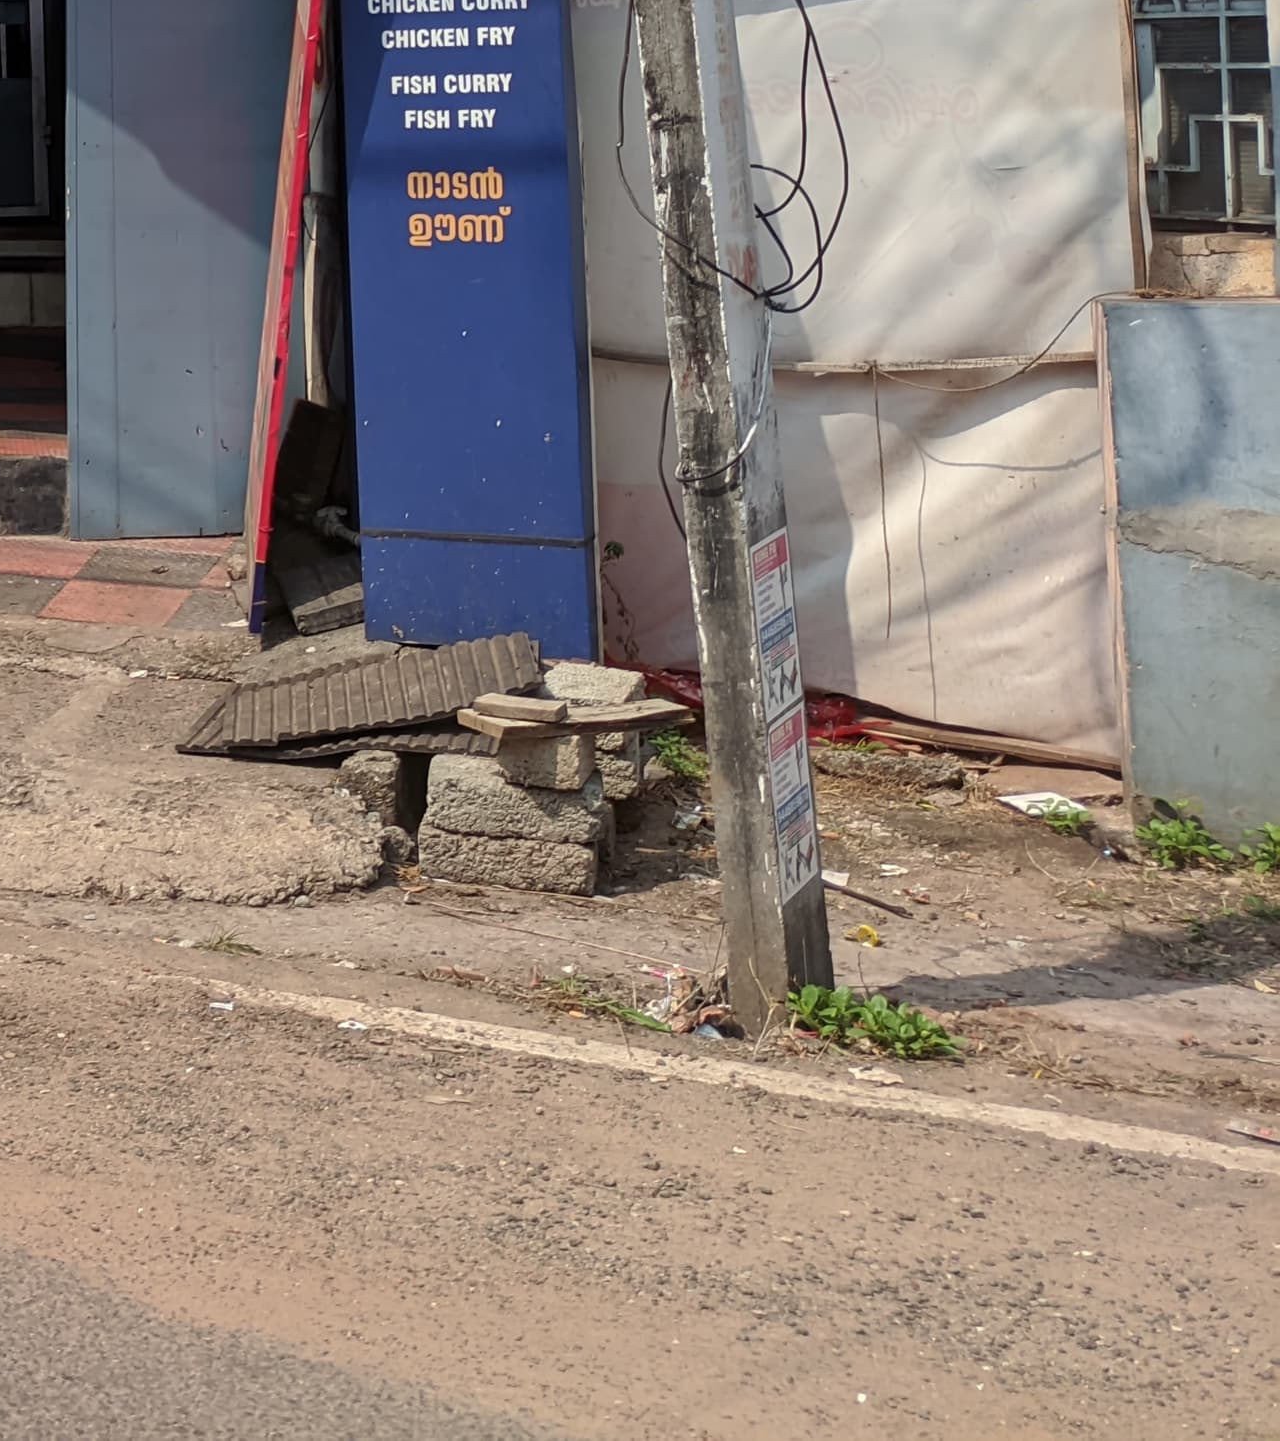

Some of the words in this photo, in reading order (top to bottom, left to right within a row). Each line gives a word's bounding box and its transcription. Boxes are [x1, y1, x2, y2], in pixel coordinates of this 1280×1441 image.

[381, 28, 469, 49] CHICKEN
[477, 26, 515, 46] FRY
[391, 75, 436, 95] FISH
[443, 73, 512, 94] CURRY
[405, 110, 450, 129] FISH
[458, 109, 496, 128] FRY
[407, 166, 503, 199] നാടൻ
[408, 206, 512, 247] ഊണ്
